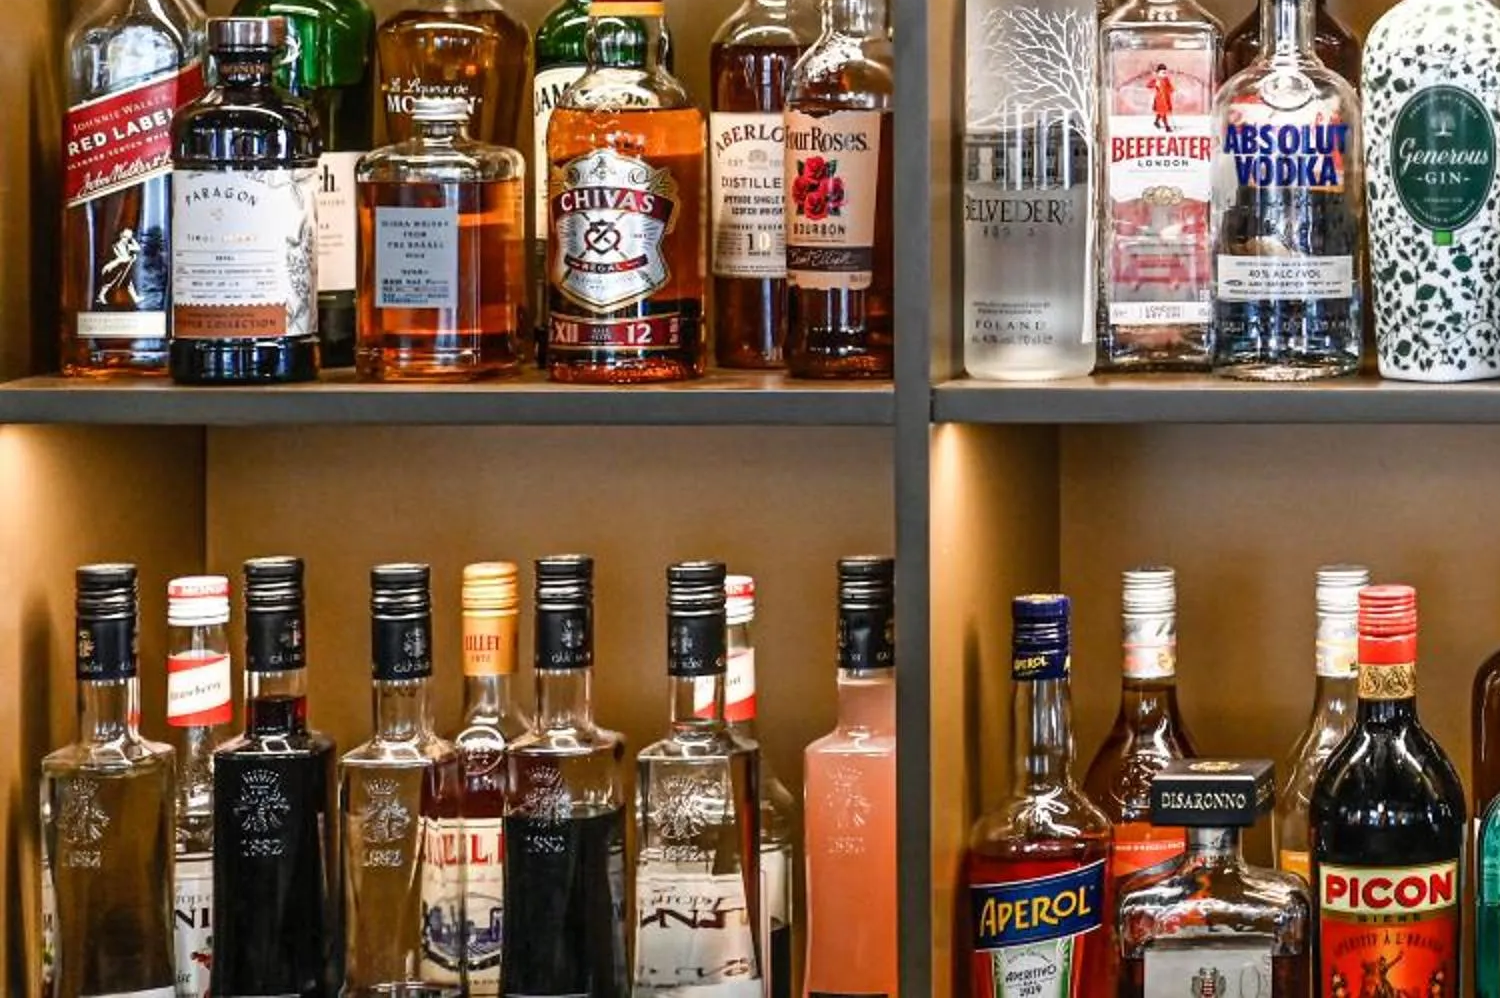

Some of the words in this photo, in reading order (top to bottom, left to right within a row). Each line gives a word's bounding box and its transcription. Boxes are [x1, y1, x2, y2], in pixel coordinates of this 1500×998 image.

[67, 131, 108, 157] RED
[715, 123, 784, 158] ABERLO
[1111, 135, 1212, 163] BEEFEATER
[1224, 123, 1349, 155] ABSOLUT
[1137, 159, 1190, 168] LONDON
[1400, 137, 1489, 176] Generous
[721, 176, 782, 189] DISTILLE
[1235, 155, 1338, 186] VODKA
[185, 186, 258, 207] PARAGON
[561, 189, 655, 212] CHIVAS
[626, 323, 653, 344] 12
[1161, 792, 1247, 812] DISARONNO
[1325, 871, 1453, 909] PICON
[980, 885, 1091, 937] APEROL
[1005, 963, 1057, 983] APERITIVO
